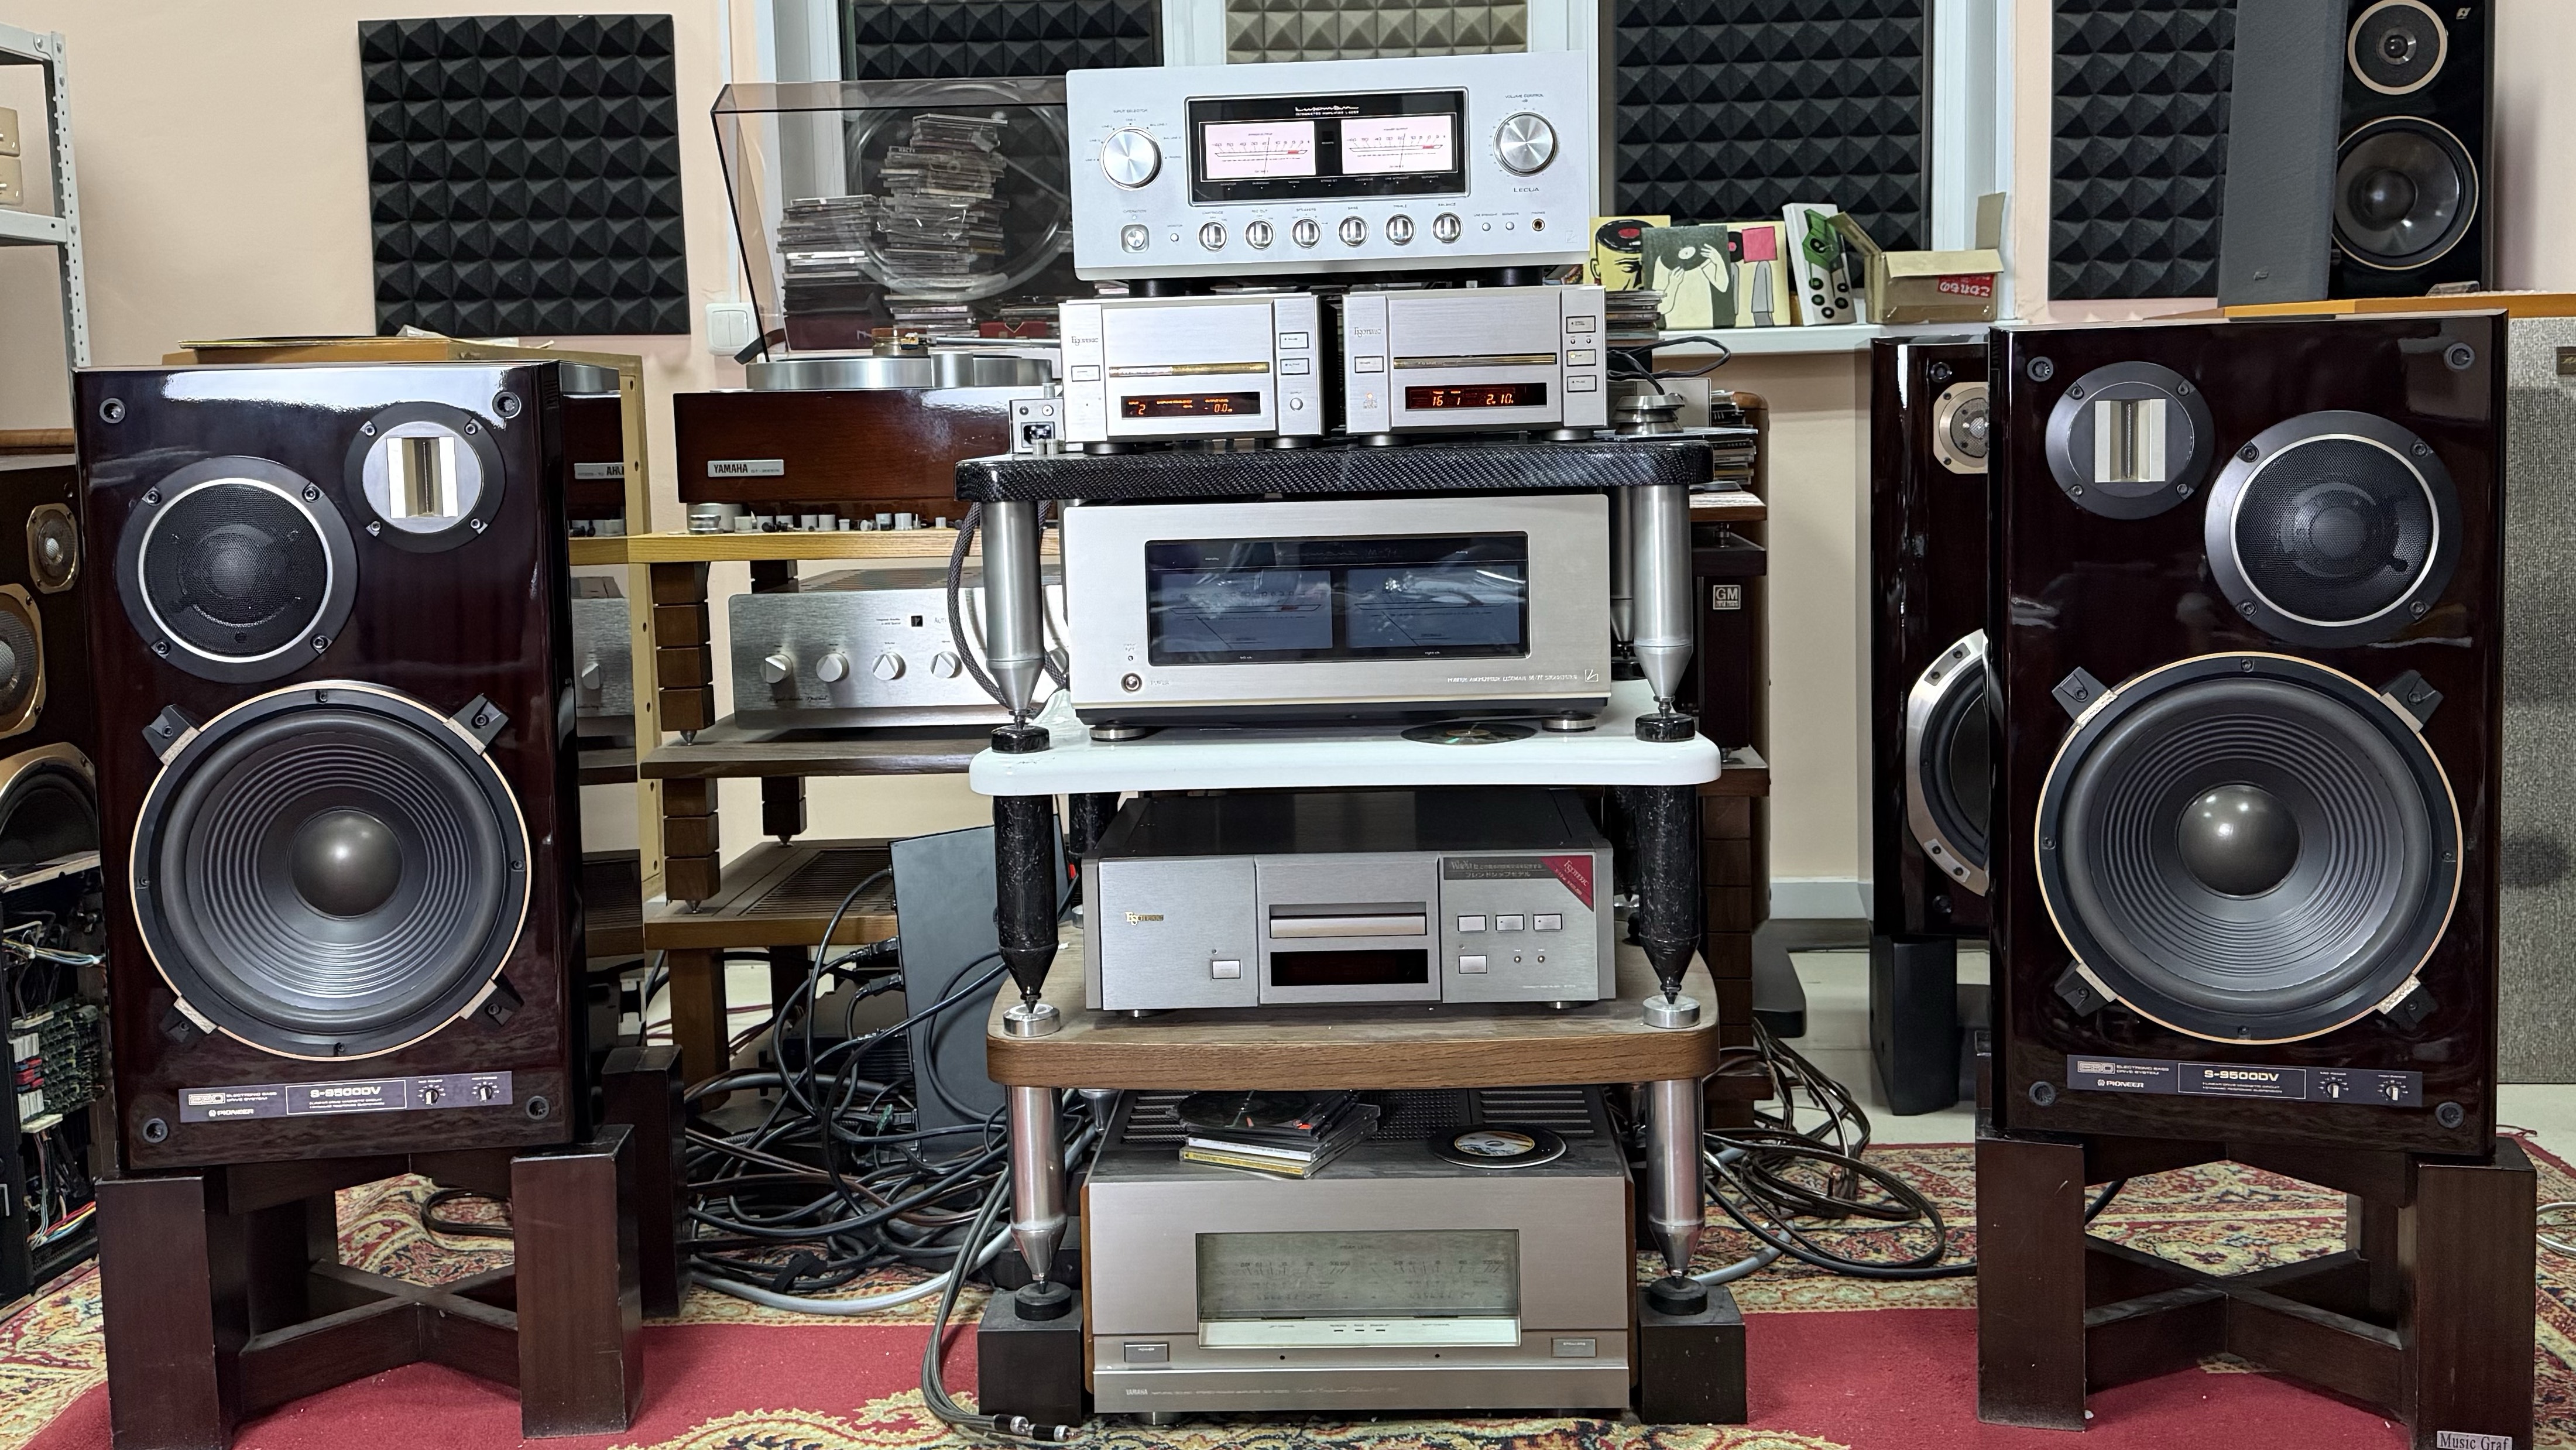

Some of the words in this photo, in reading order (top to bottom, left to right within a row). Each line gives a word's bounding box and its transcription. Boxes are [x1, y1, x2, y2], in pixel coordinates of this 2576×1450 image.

[1939, 282, 1991, 297] こわれもの
[1433, 395, 1443, 406] 16
[1457, 397, 1460, 406] 1
[714, 464, 749, 474] YAMAHA
[1716, 587, 1738, 600] GM
[2204, 1069, 2279, 1082] S-9500DV
[2106, 1080, 2144, 1088] PIONEER
[310, 1086, 382, 1098] S-9500DV
[2440, 1432, 2476, 1450] Music
[2481, 1436, 2509, 1450] Graf
